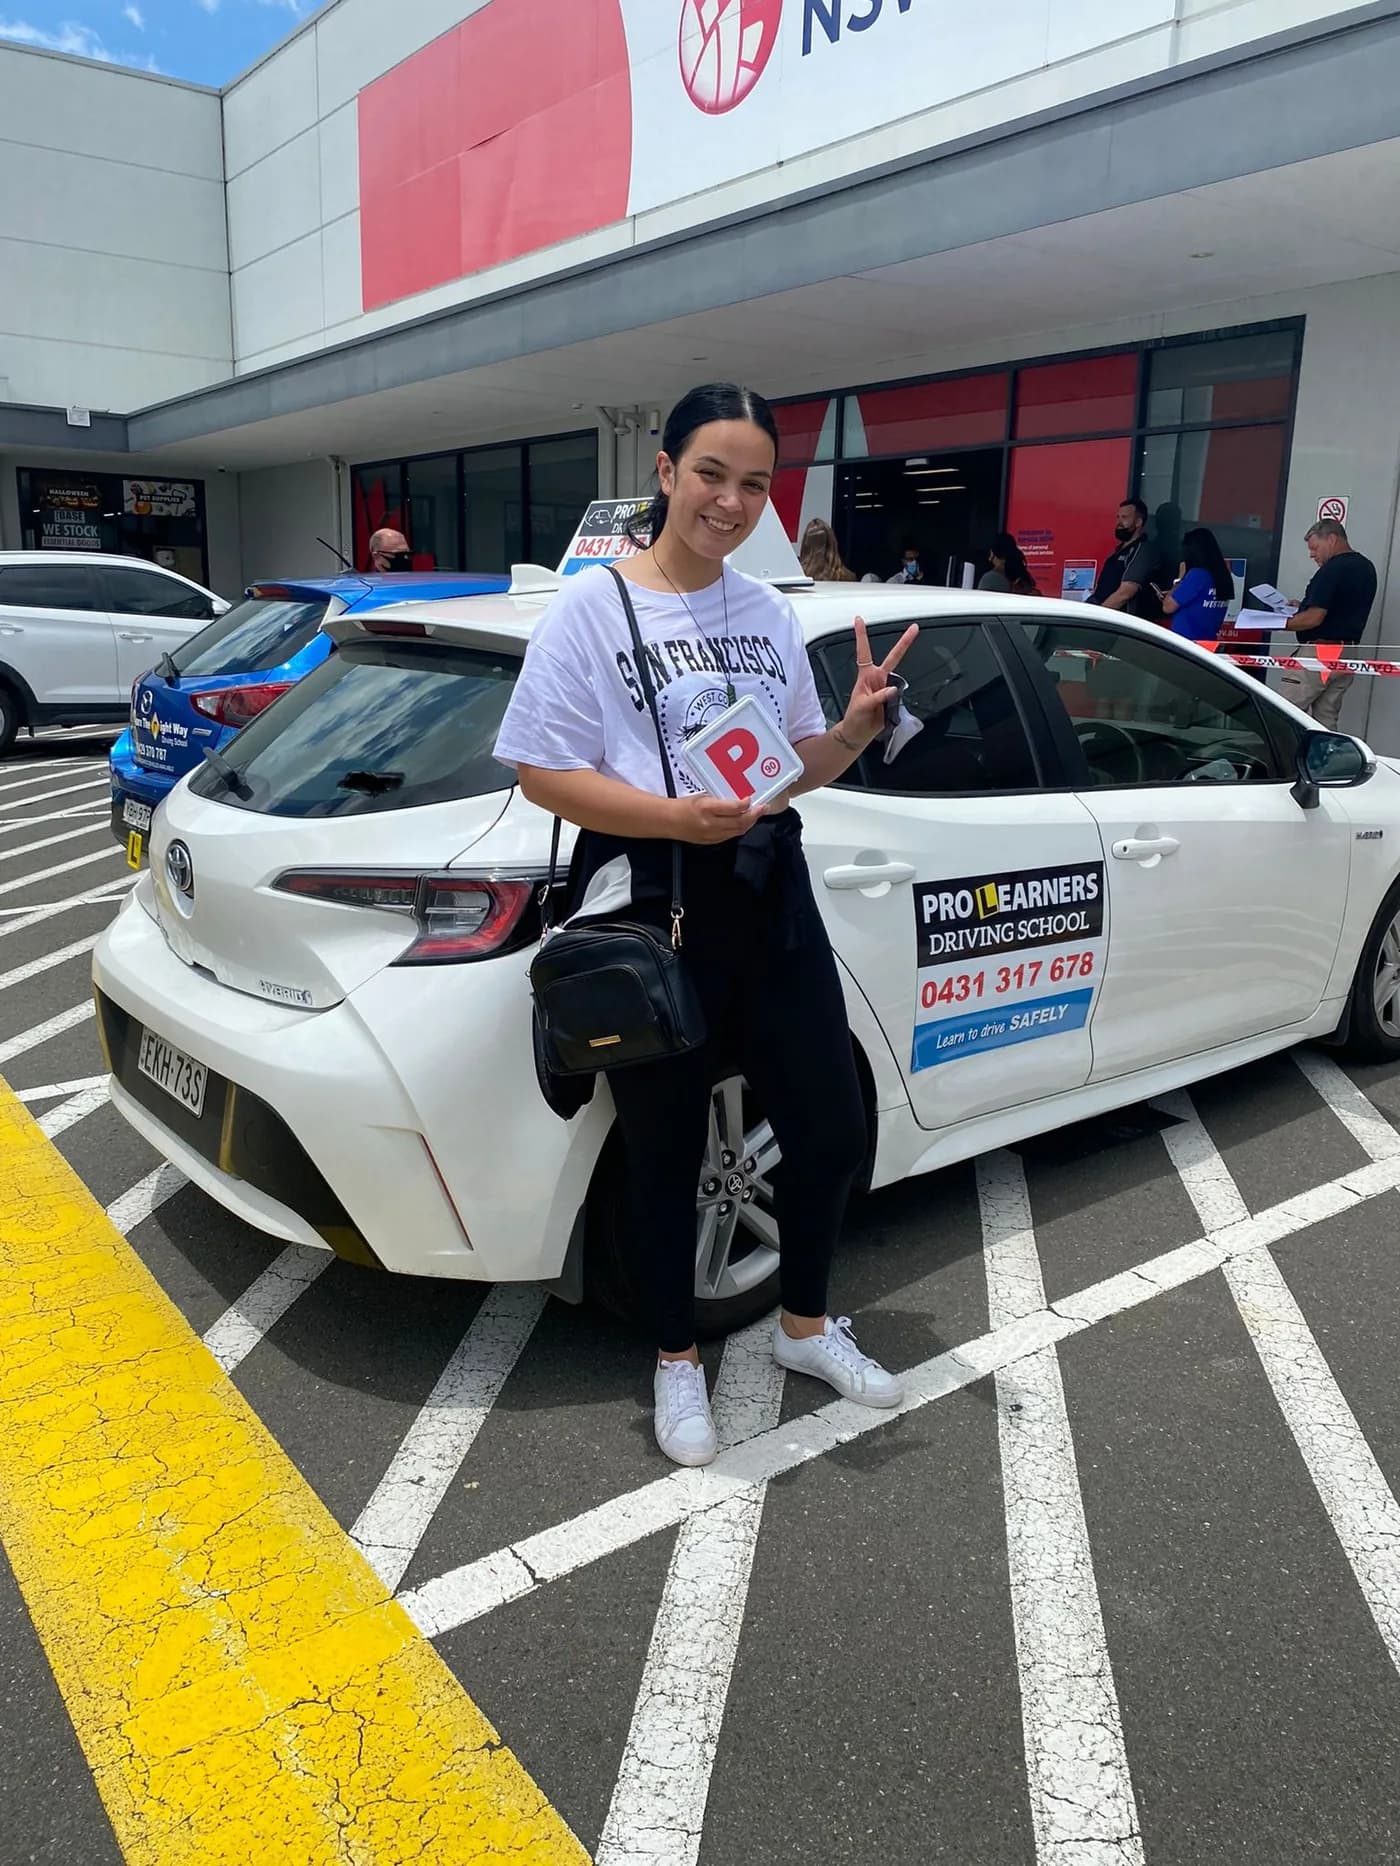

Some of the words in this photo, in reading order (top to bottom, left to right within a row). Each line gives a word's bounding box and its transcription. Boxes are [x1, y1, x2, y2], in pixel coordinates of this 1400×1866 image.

[802, 0, 913, 56] NS
[43, 523, 61, 536] WE
[64, 524, 98, 537] STOCK
[575, 538, 613, 556] 0431
[616, 643, 672, 712] SN
[664, 635, 788, 686] FRANCISCO
[1238, 657, 1297, 668] DANGER
[1329, 661, 1393, 673] DANGER
[694, 691, 716, 712] WEST
[173, 723, 188, 739] Way
[704, 728, 759, 800] P
[764, 760, 777, 774] 90
[922, 889, 974, 924] PRO
[975, 873, 1099, 920] LEARNERS
[929, 923, 1015, 955] DRIVING
[1017, 911, 1090, 941] SCHOOL
[921, 971, 985, 1009] 0431
[995, 961, 1043, 993] 317
[1049, 951, 1094, 982] 678
[936, 1032, 965, 1049] Learn
[967, 1027, 978, 1041] to
[980, 1022, 1005, 1038] drive
[1009, 1004, 1069, 1031] SAFELY
